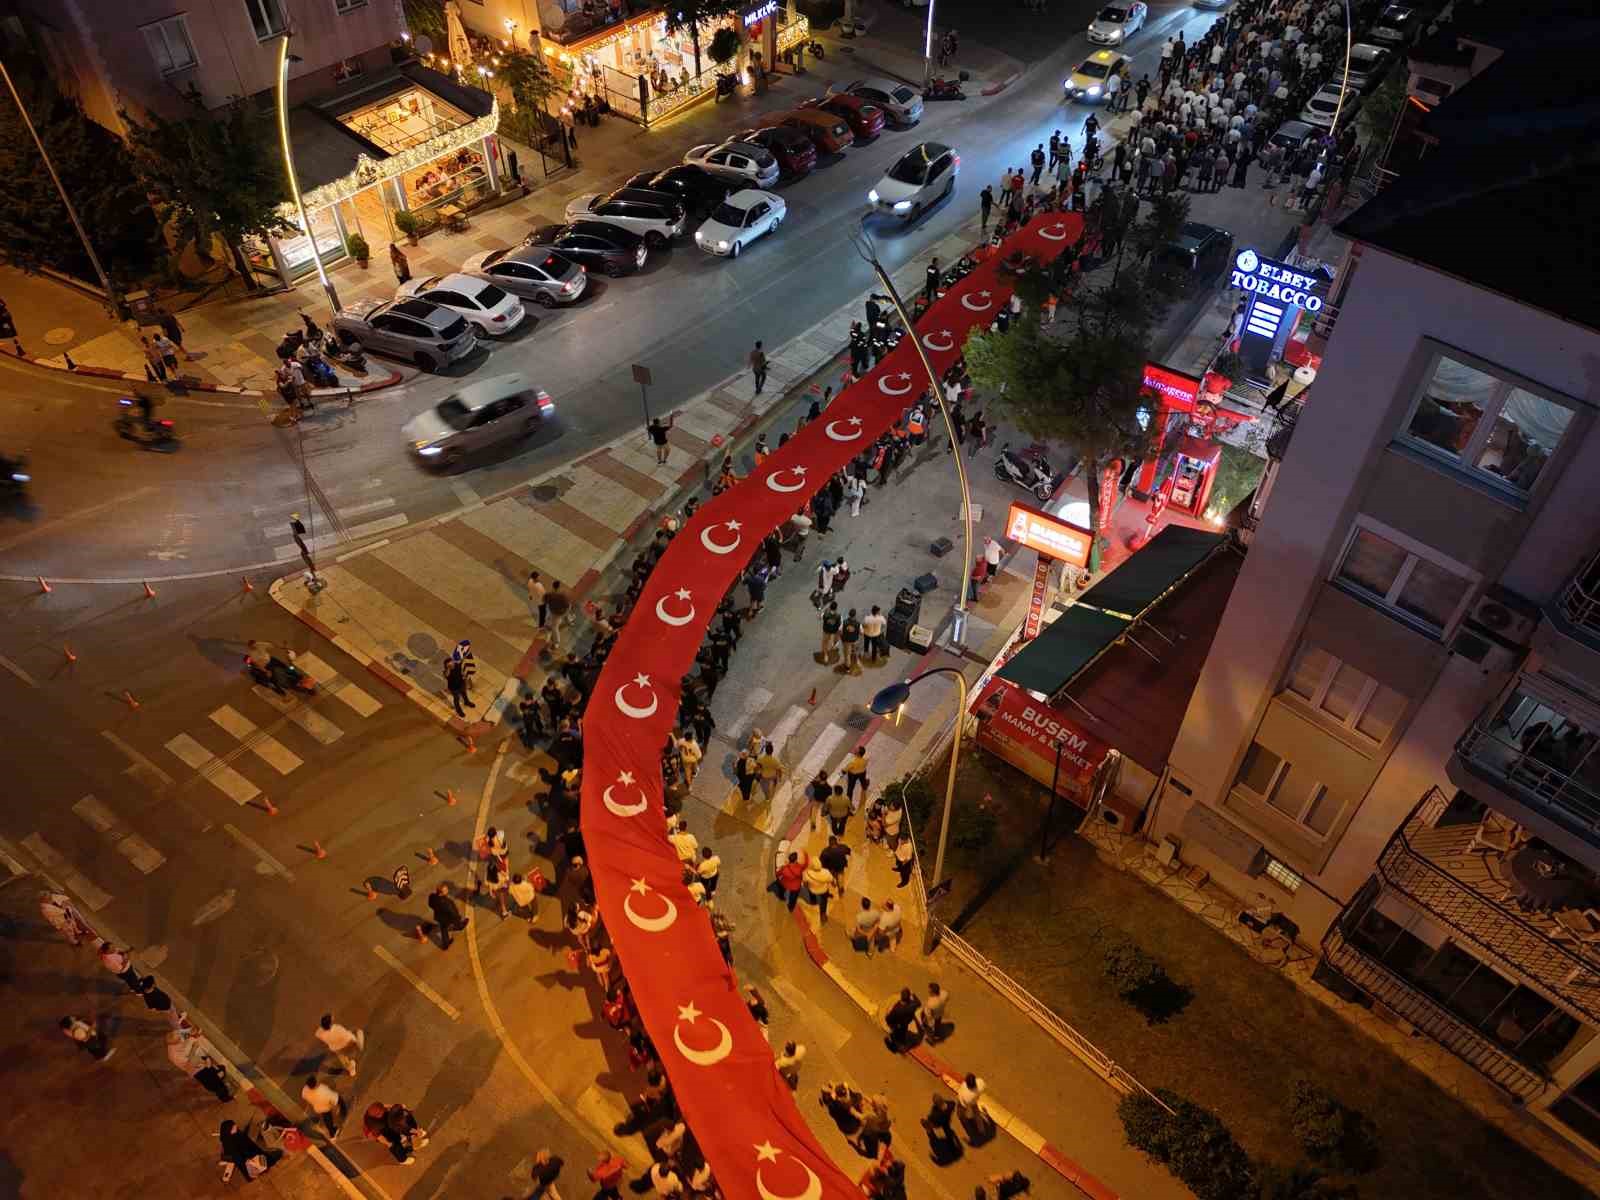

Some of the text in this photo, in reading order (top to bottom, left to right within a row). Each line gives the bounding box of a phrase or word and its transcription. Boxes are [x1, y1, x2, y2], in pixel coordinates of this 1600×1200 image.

[1232, 271, 1322, 311] TOBACCO
[1258, 263, 1317, 290] ELBEY
[1002, 712, 1039, 738] MANAV
[1038, 734, 1047, 743] &
[1021, 707, 1088, 752] BUSEM
